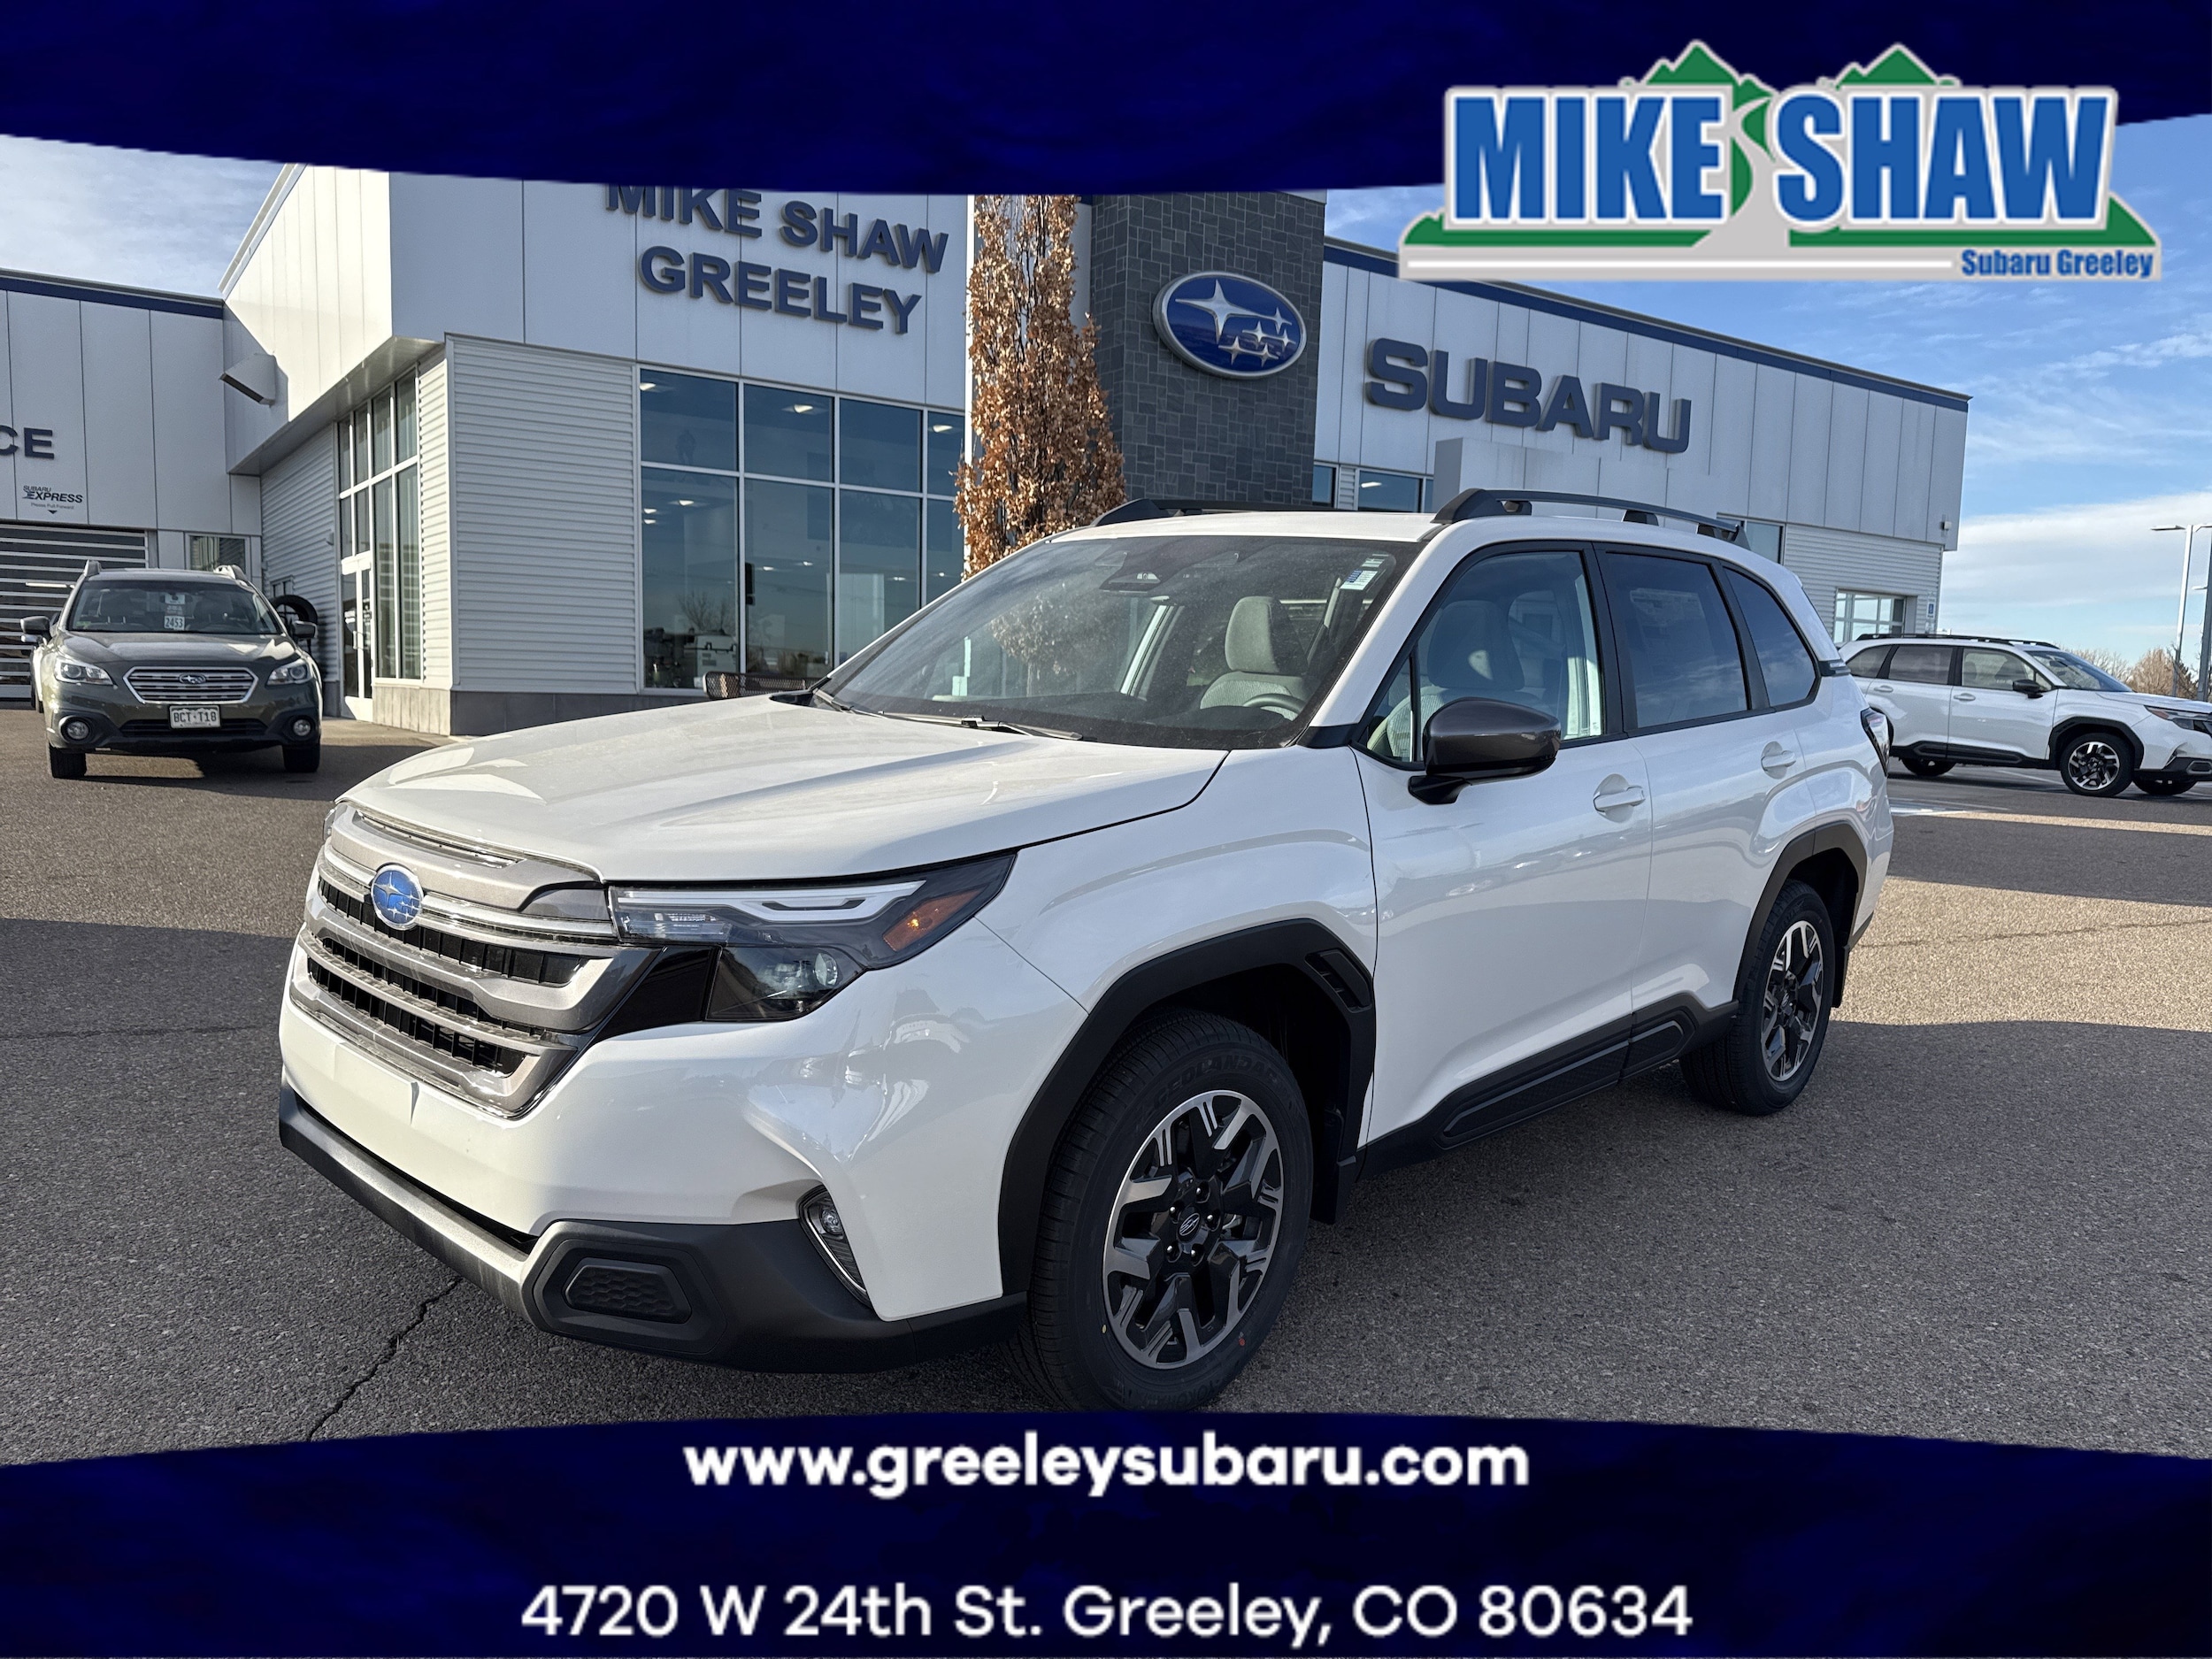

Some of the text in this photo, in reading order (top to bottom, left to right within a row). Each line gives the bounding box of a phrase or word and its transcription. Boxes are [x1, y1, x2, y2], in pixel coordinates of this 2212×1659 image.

[606, 184, 949, 274] MIKE SHAW
[638, 245, 922, 334] GREELEY
[1364, 337, 1692, 454] SUBARU
[23, 491, 83, 503] EXPRESS
